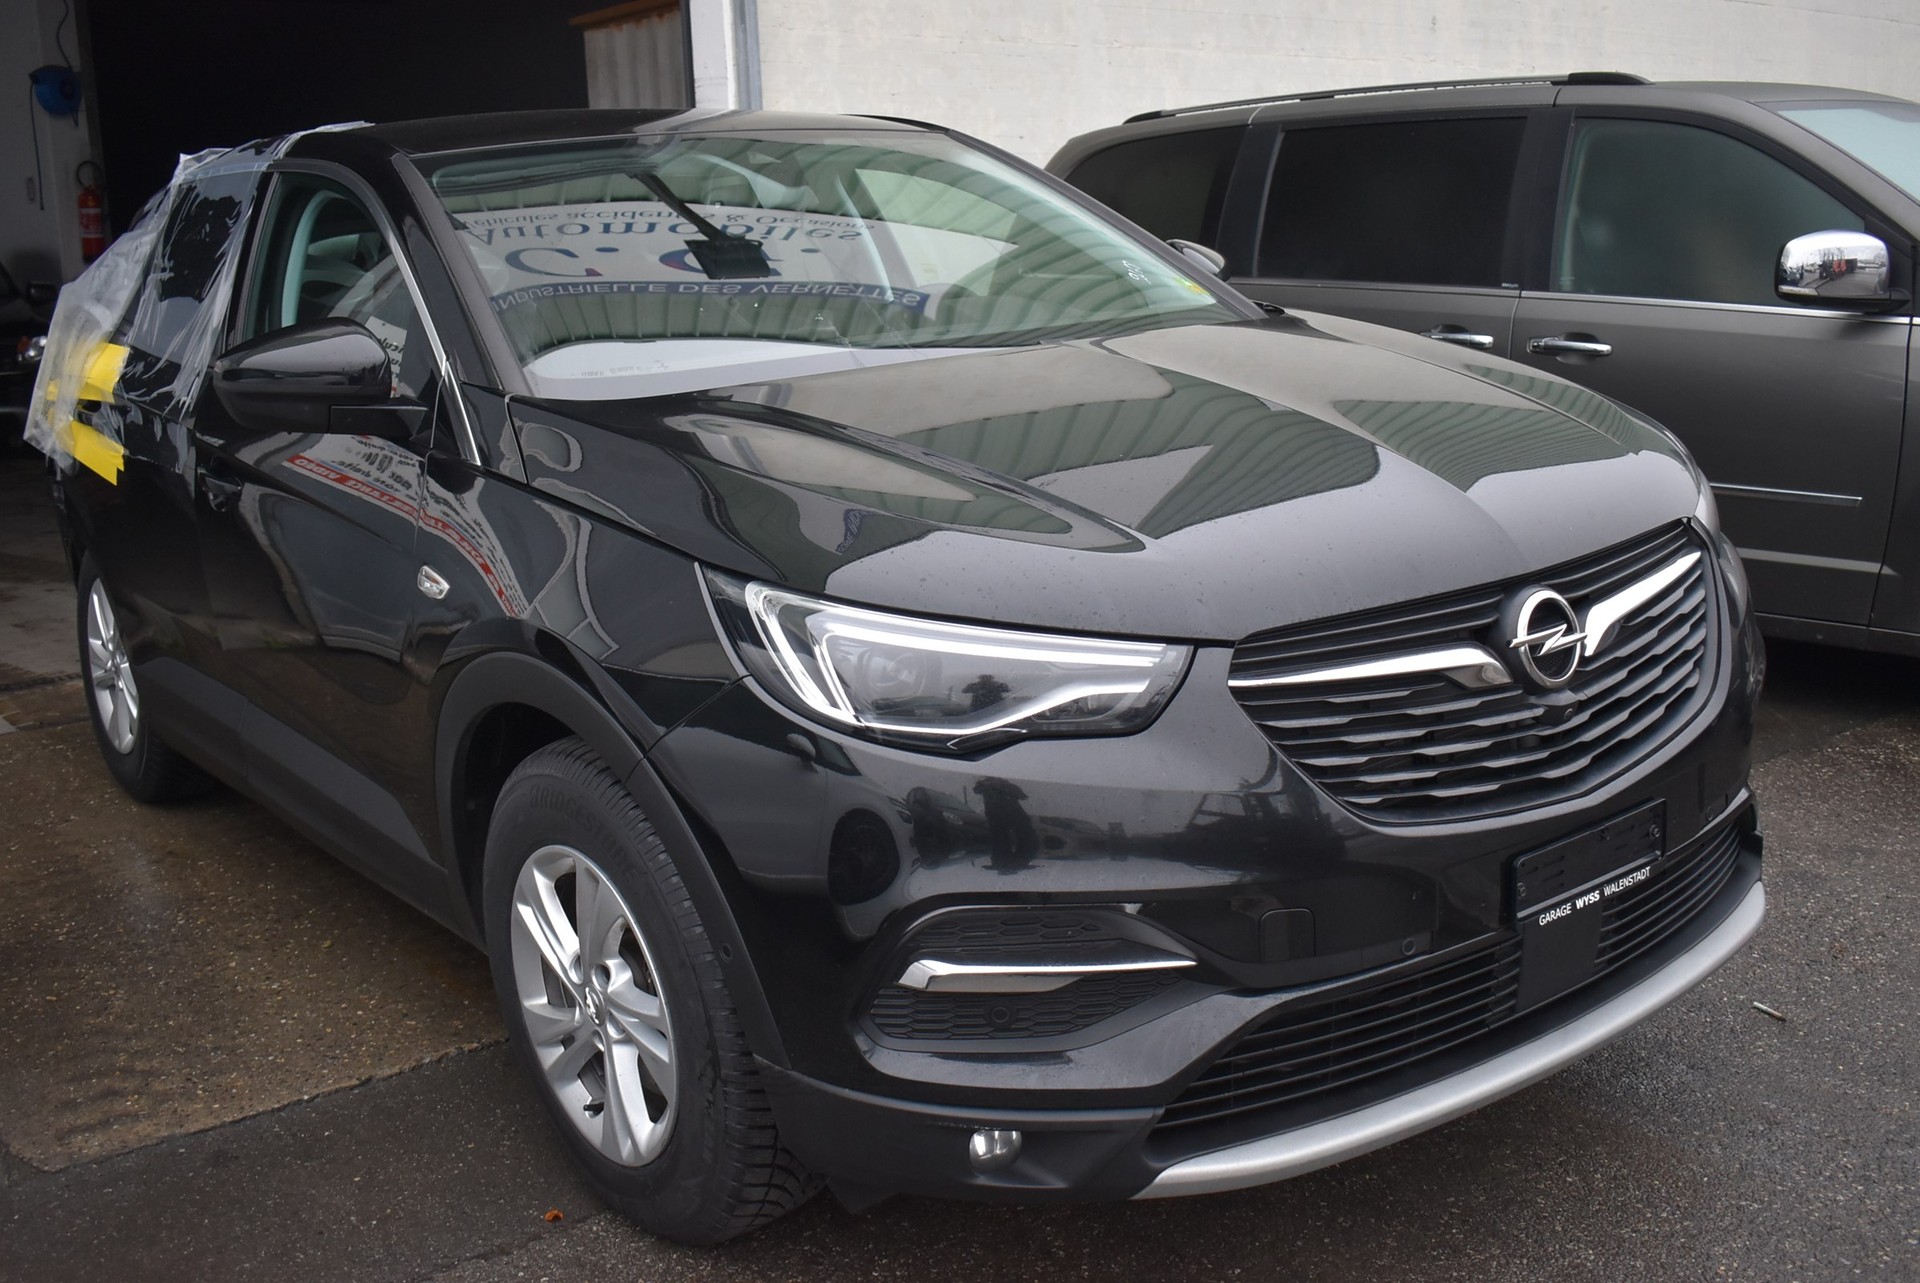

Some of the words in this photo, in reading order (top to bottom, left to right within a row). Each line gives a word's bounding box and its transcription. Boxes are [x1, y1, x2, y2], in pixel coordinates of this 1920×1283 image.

[528, 784, 637, 881] BRIDGESTONE
[1538, 902, 1573, 926] GARAGE
[1575, 890, 1600, 910] WYSS
[1603, 866, 1651, 897] WALENSTADT
